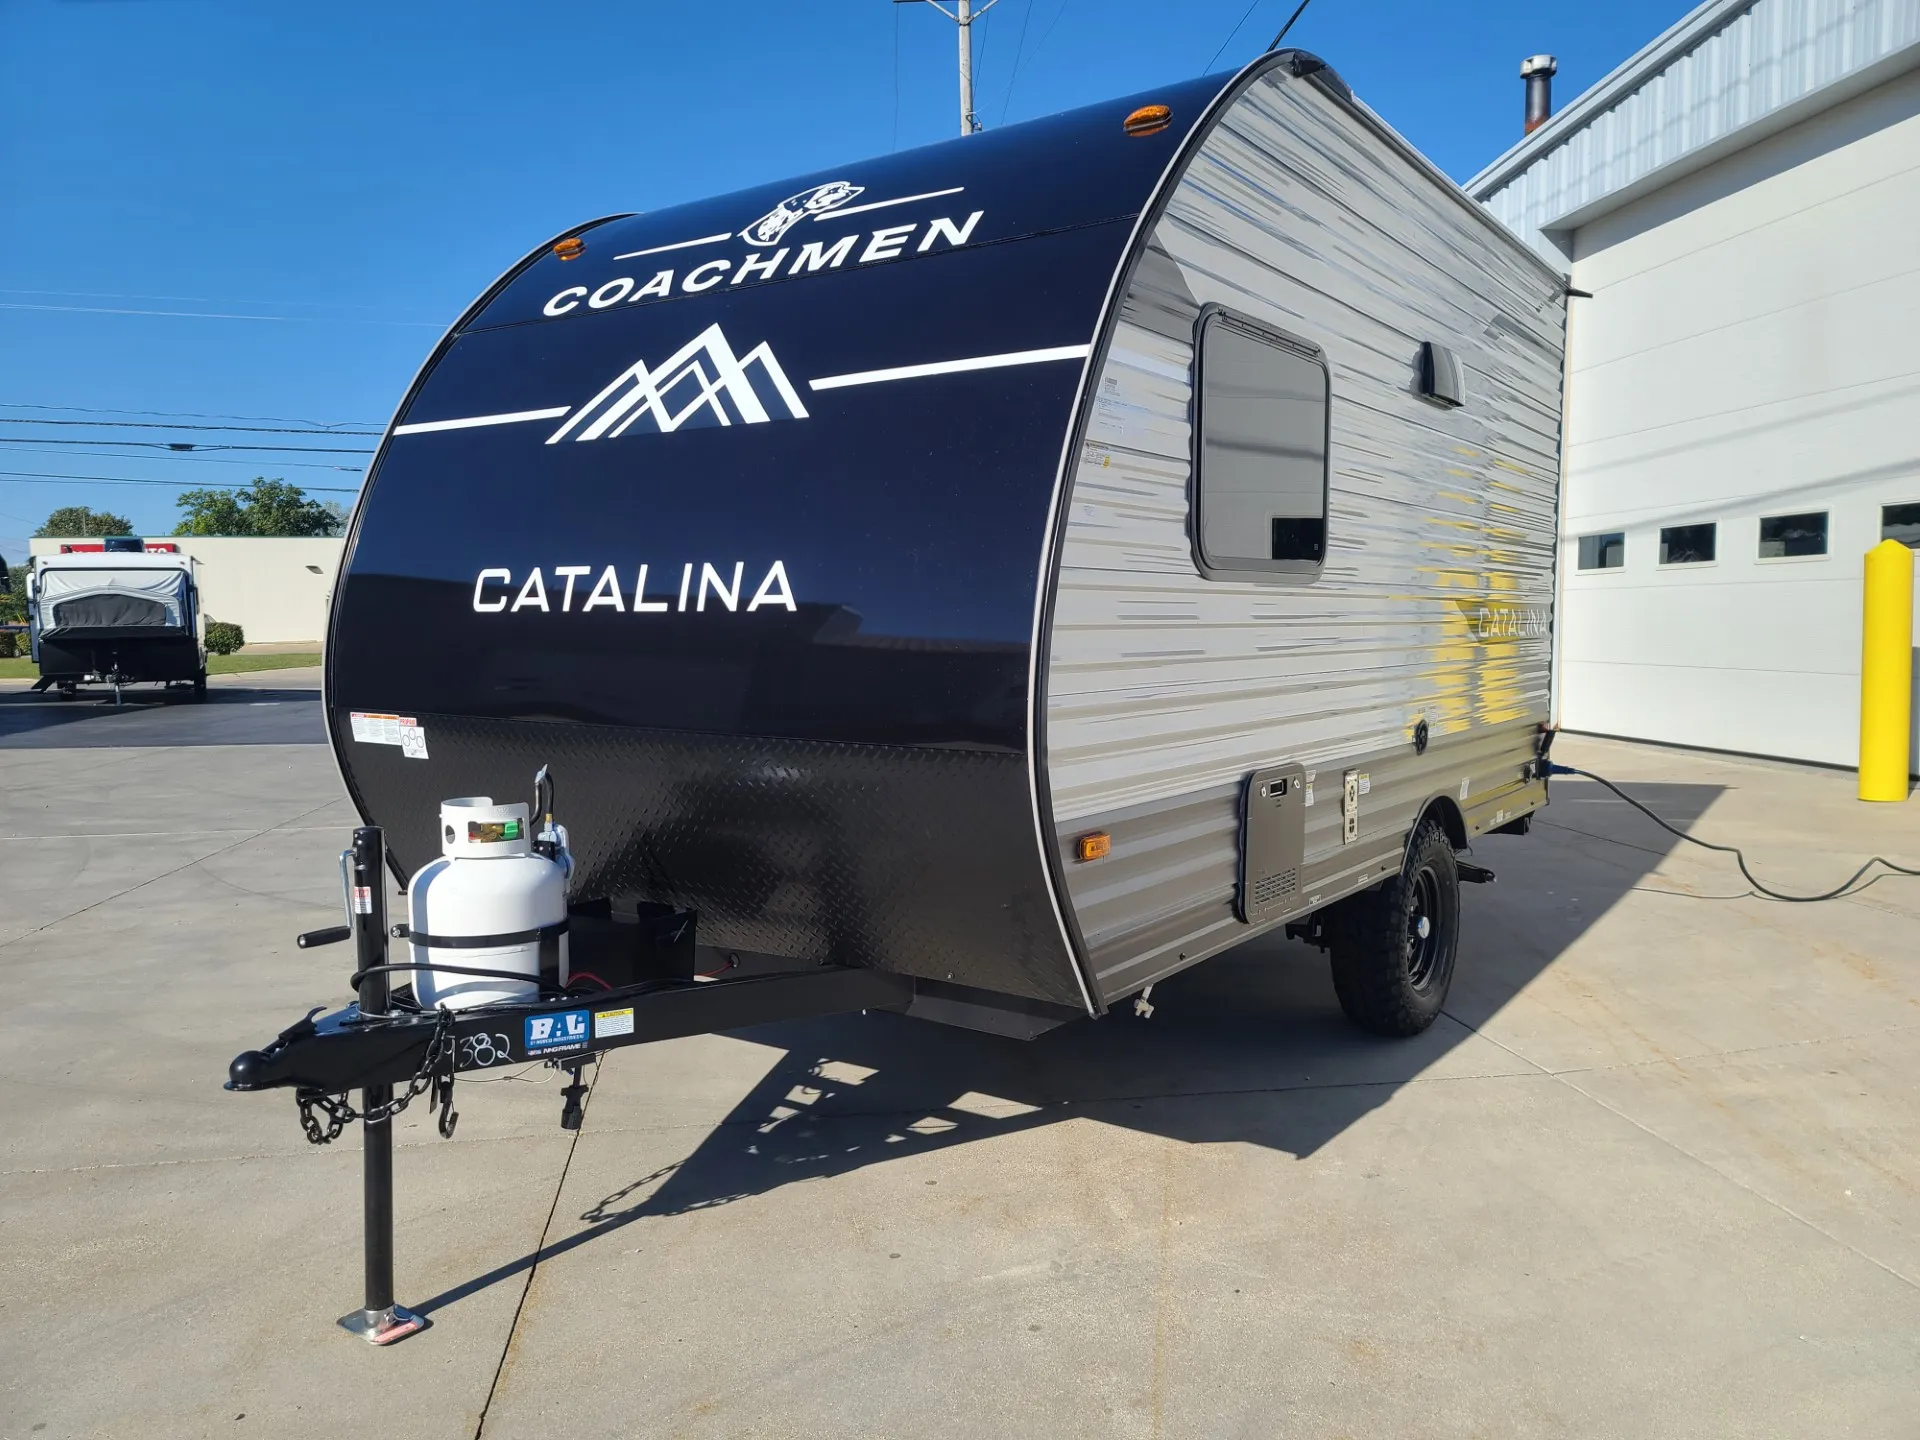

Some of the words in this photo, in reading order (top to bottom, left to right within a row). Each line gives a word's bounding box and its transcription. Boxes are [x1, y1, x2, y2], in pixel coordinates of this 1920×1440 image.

[543, 211, 984, 316] COACHMEN
[473, 560, 797, 612] CATALINA
[1479, 608, 1548, 637] CATALINA
